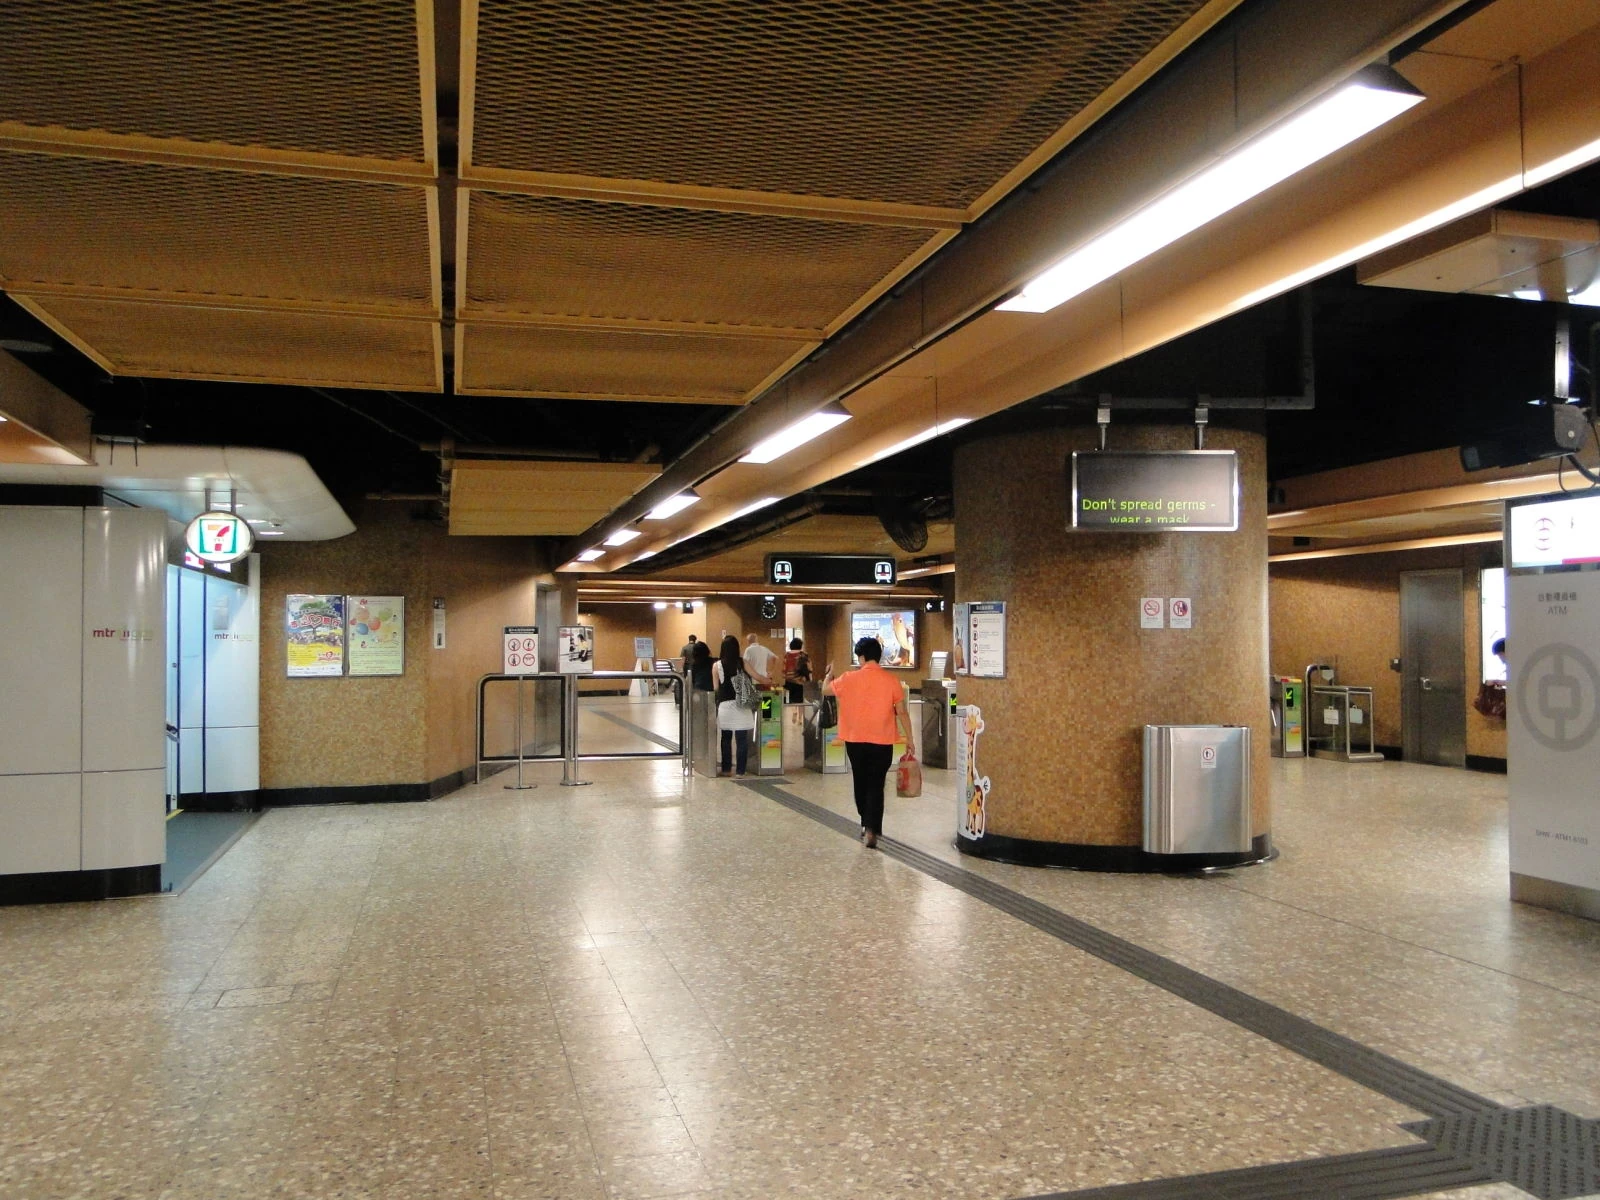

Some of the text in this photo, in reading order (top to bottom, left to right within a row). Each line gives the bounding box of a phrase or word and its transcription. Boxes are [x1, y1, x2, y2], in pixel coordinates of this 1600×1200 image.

[1082, 498, 1116, 510] Don't
[1120, 498, 1162, 512] spread
[1167, 501, 1206, 512] germs
[1157, 514, 1190, 523] mask
[1547, 606, 1567, 615] ATM
[93, 628, 115, 637] mtr
